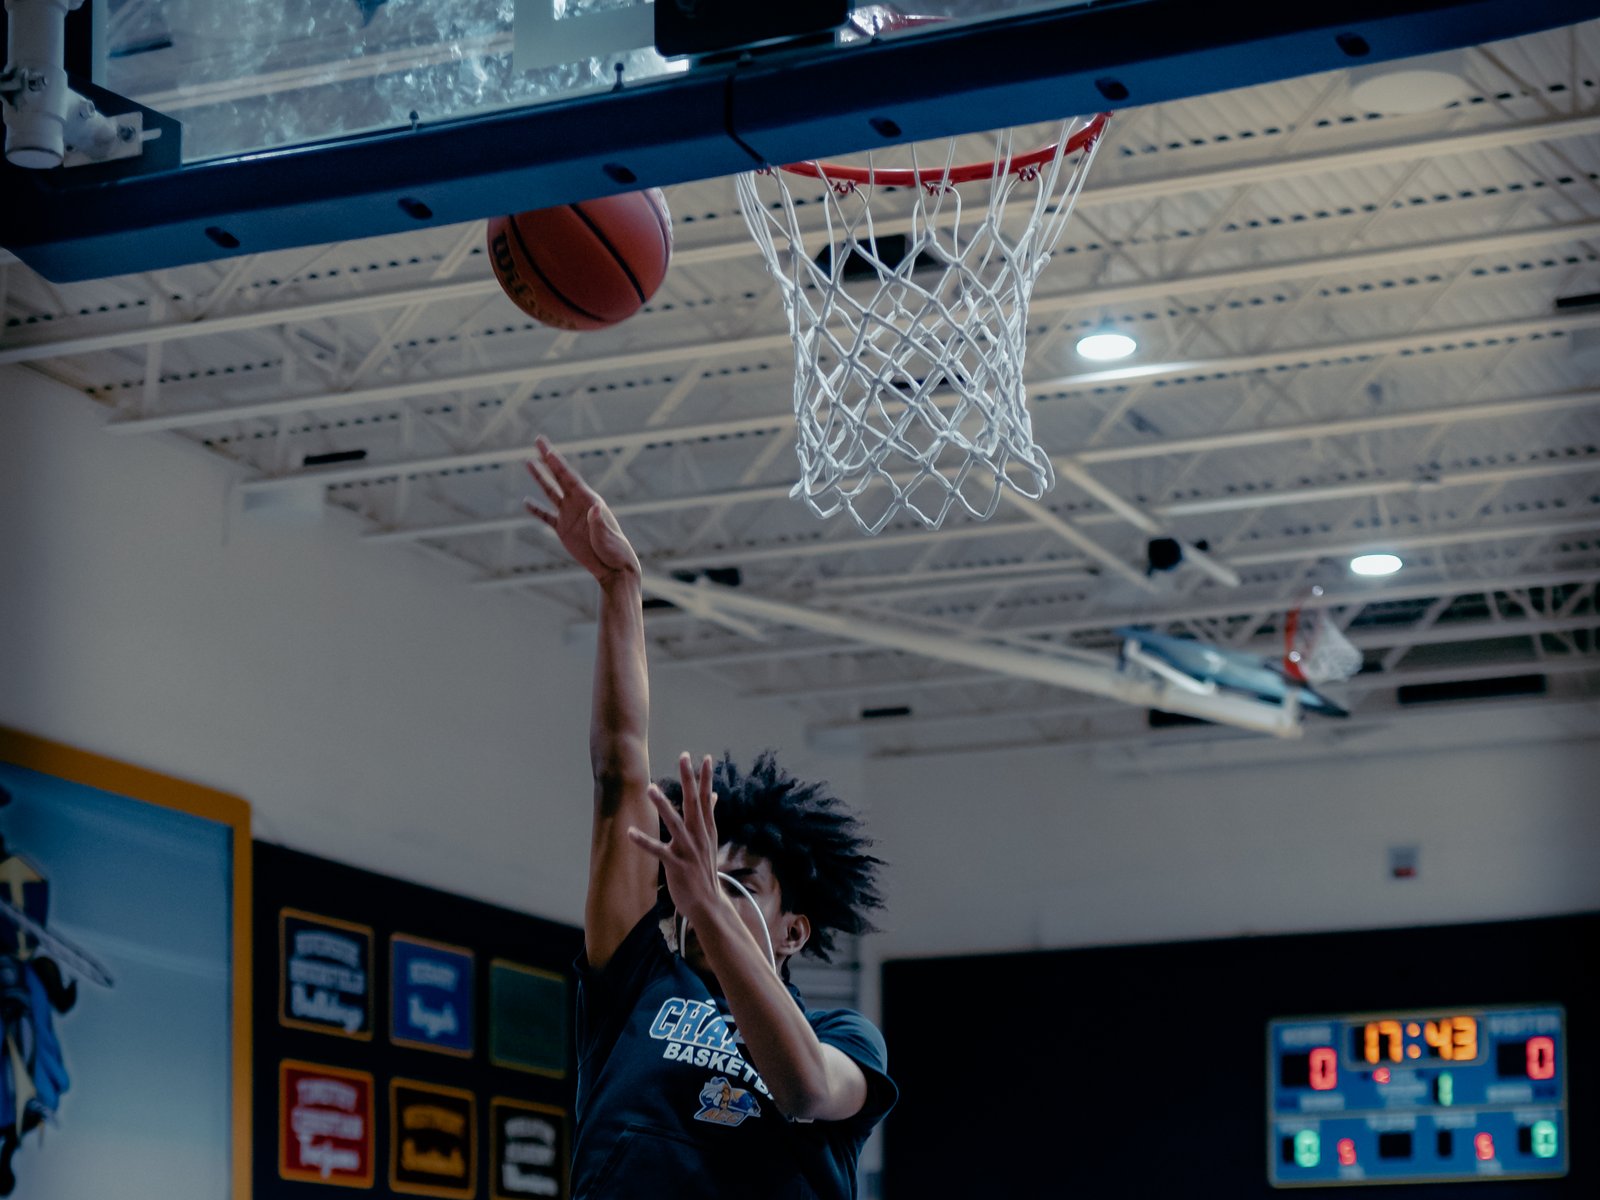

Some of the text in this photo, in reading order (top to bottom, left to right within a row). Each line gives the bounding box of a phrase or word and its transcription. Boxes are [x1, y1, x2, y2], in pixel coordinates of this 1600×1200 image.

[1364, 1016, 1478, 1065] 17:43
[1525, 1035, 1556, 1080] 0
[662, 1042, 774, 1101] BASKETB
[1308, 1047, 1338, 1091] 0
[1437, 1071, 1454, 1107] 1
